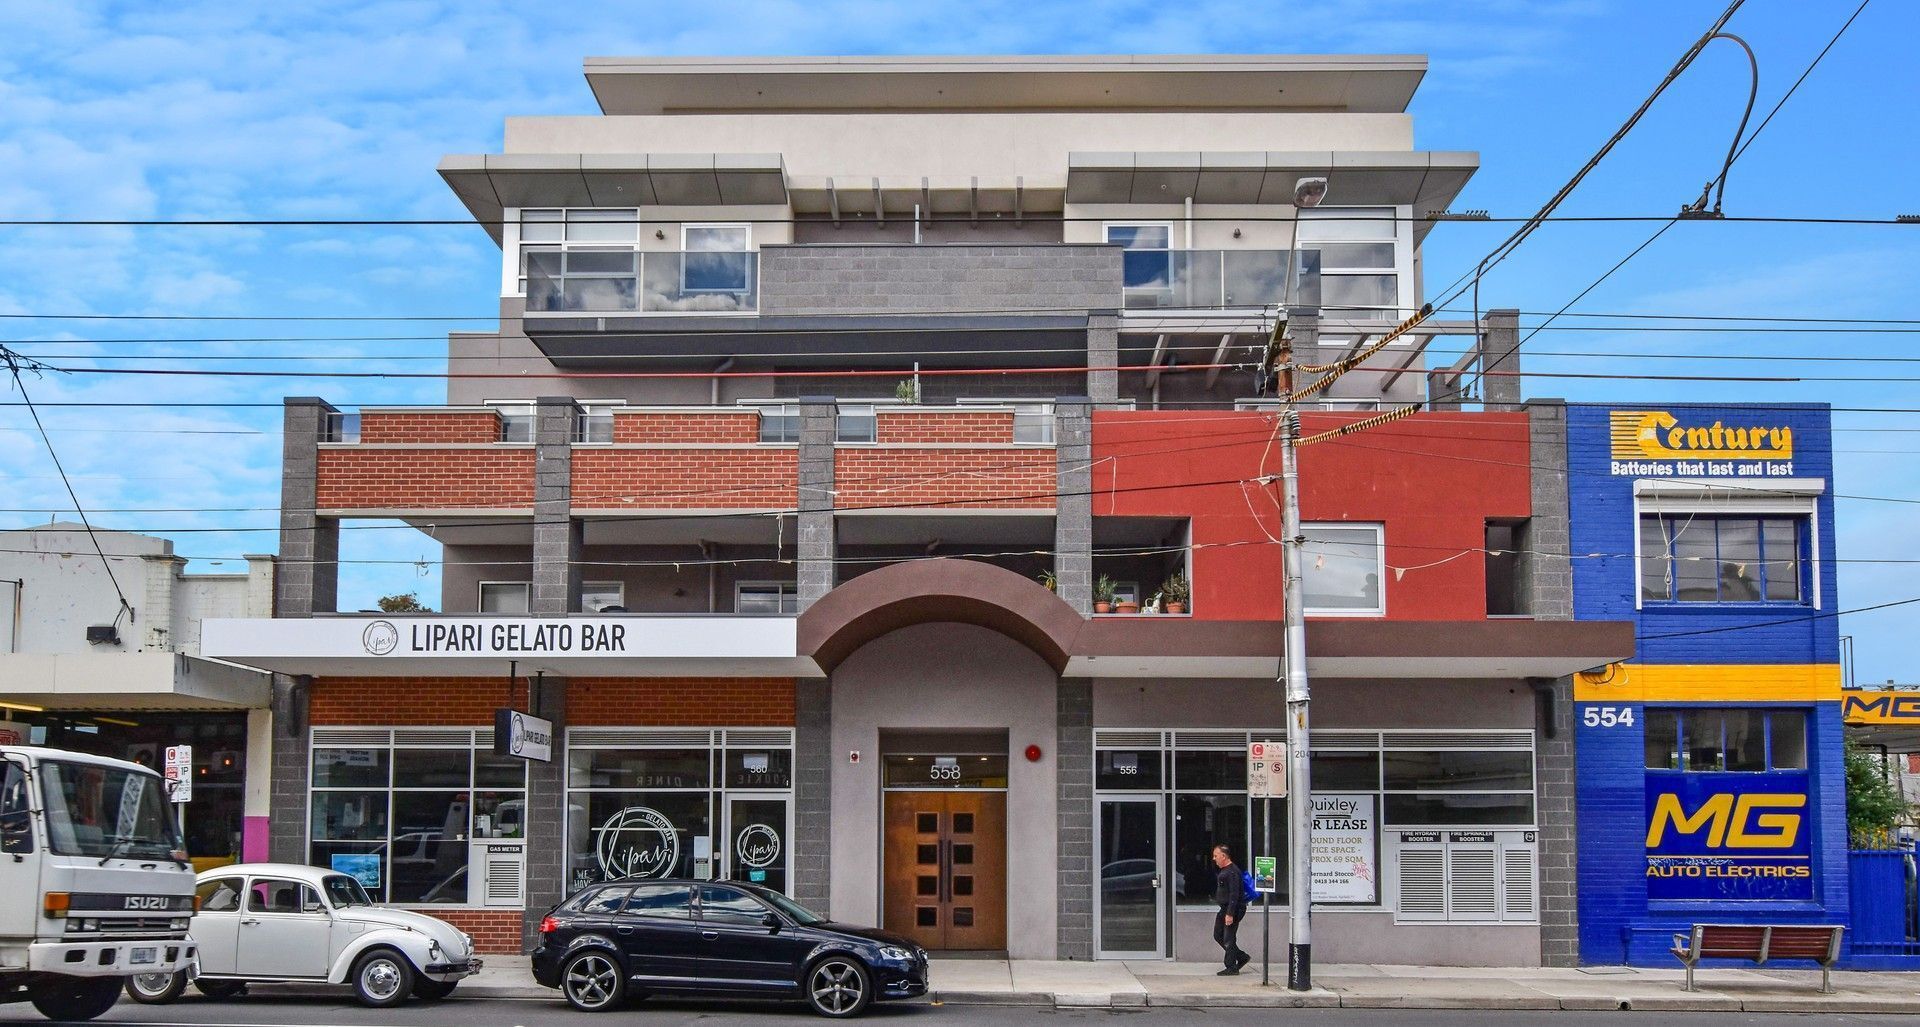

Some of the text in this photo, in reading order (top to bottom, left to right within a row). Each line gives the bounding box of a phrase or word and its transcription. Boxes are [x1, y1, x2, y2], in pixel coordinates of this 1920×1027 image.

[1637, 411, 1793, 459] Century
[1611, 461, 1793, 475] Batteries that last and last
[412, 624, 482, 651] LIPARI
[491, 624, 573, 651] GELATO
[581, 624, 626, 651] BAR
[1843, 696, 1920, 717] MG
[1583, 707, 1635, 727] 554
[750, 765, 767, 773] 560
[930, 765, 960, 780] 558
[1120, 766, 1137, 775] 556
[1252, 763, 1281, 772] 1P S
[1326, 820, 1367, 830] LEASE
[1645, 793, 1807, 848] MG
[1646, 866, 1810, 877] AUTO ELECTRICS
[124, 896, 169, 910] ISUZU
